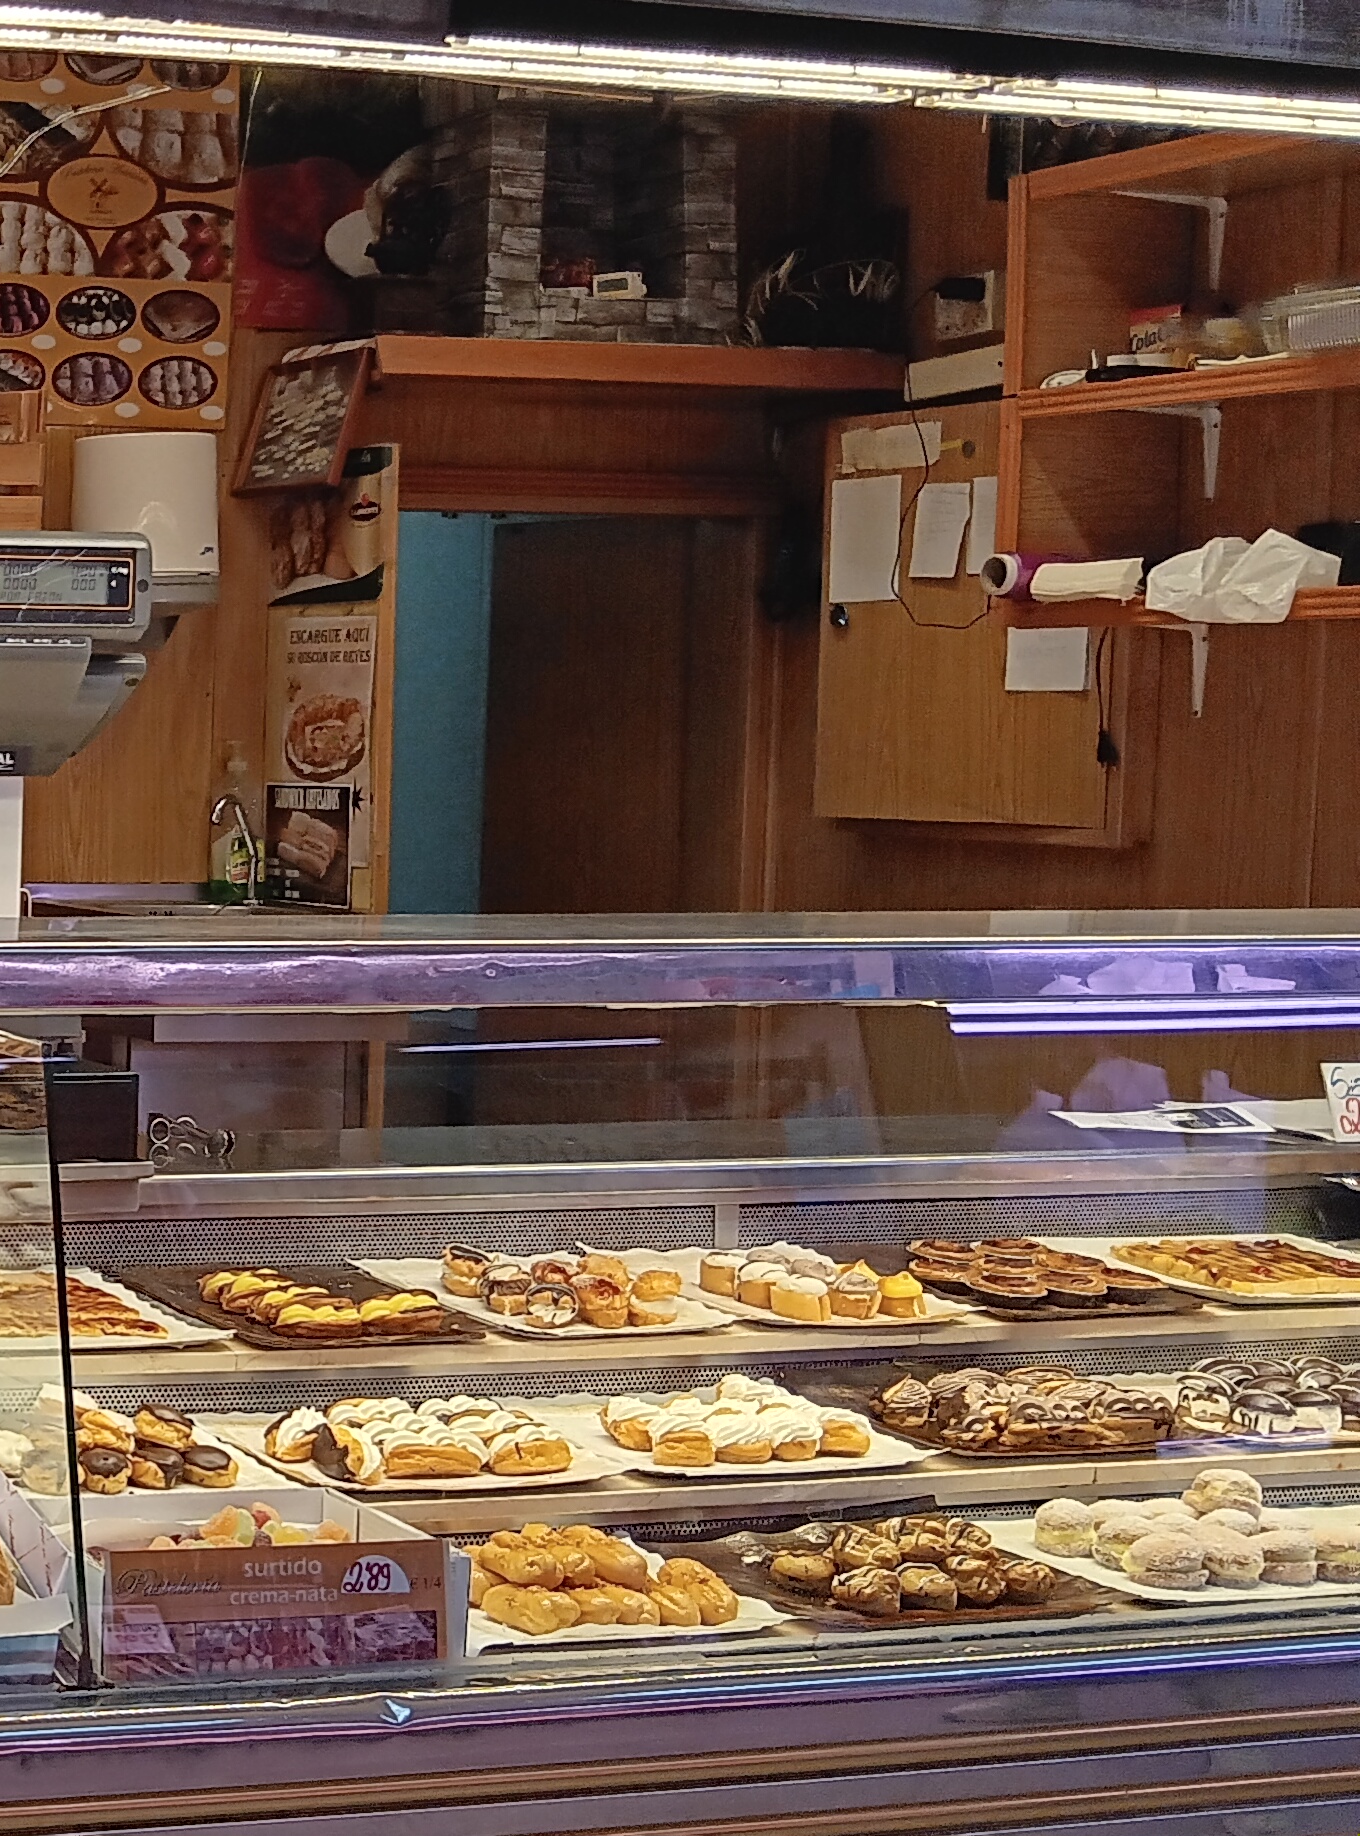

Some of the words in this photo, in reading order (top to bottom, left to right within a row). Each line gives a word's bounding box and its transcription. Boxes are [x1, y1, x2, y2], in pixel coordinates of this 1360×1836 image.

[244, 1558, 322, 1577] surtido
[343, 1561, 392, 1592] 2'89
[230, 1586, 338, 1606] crema-nata
